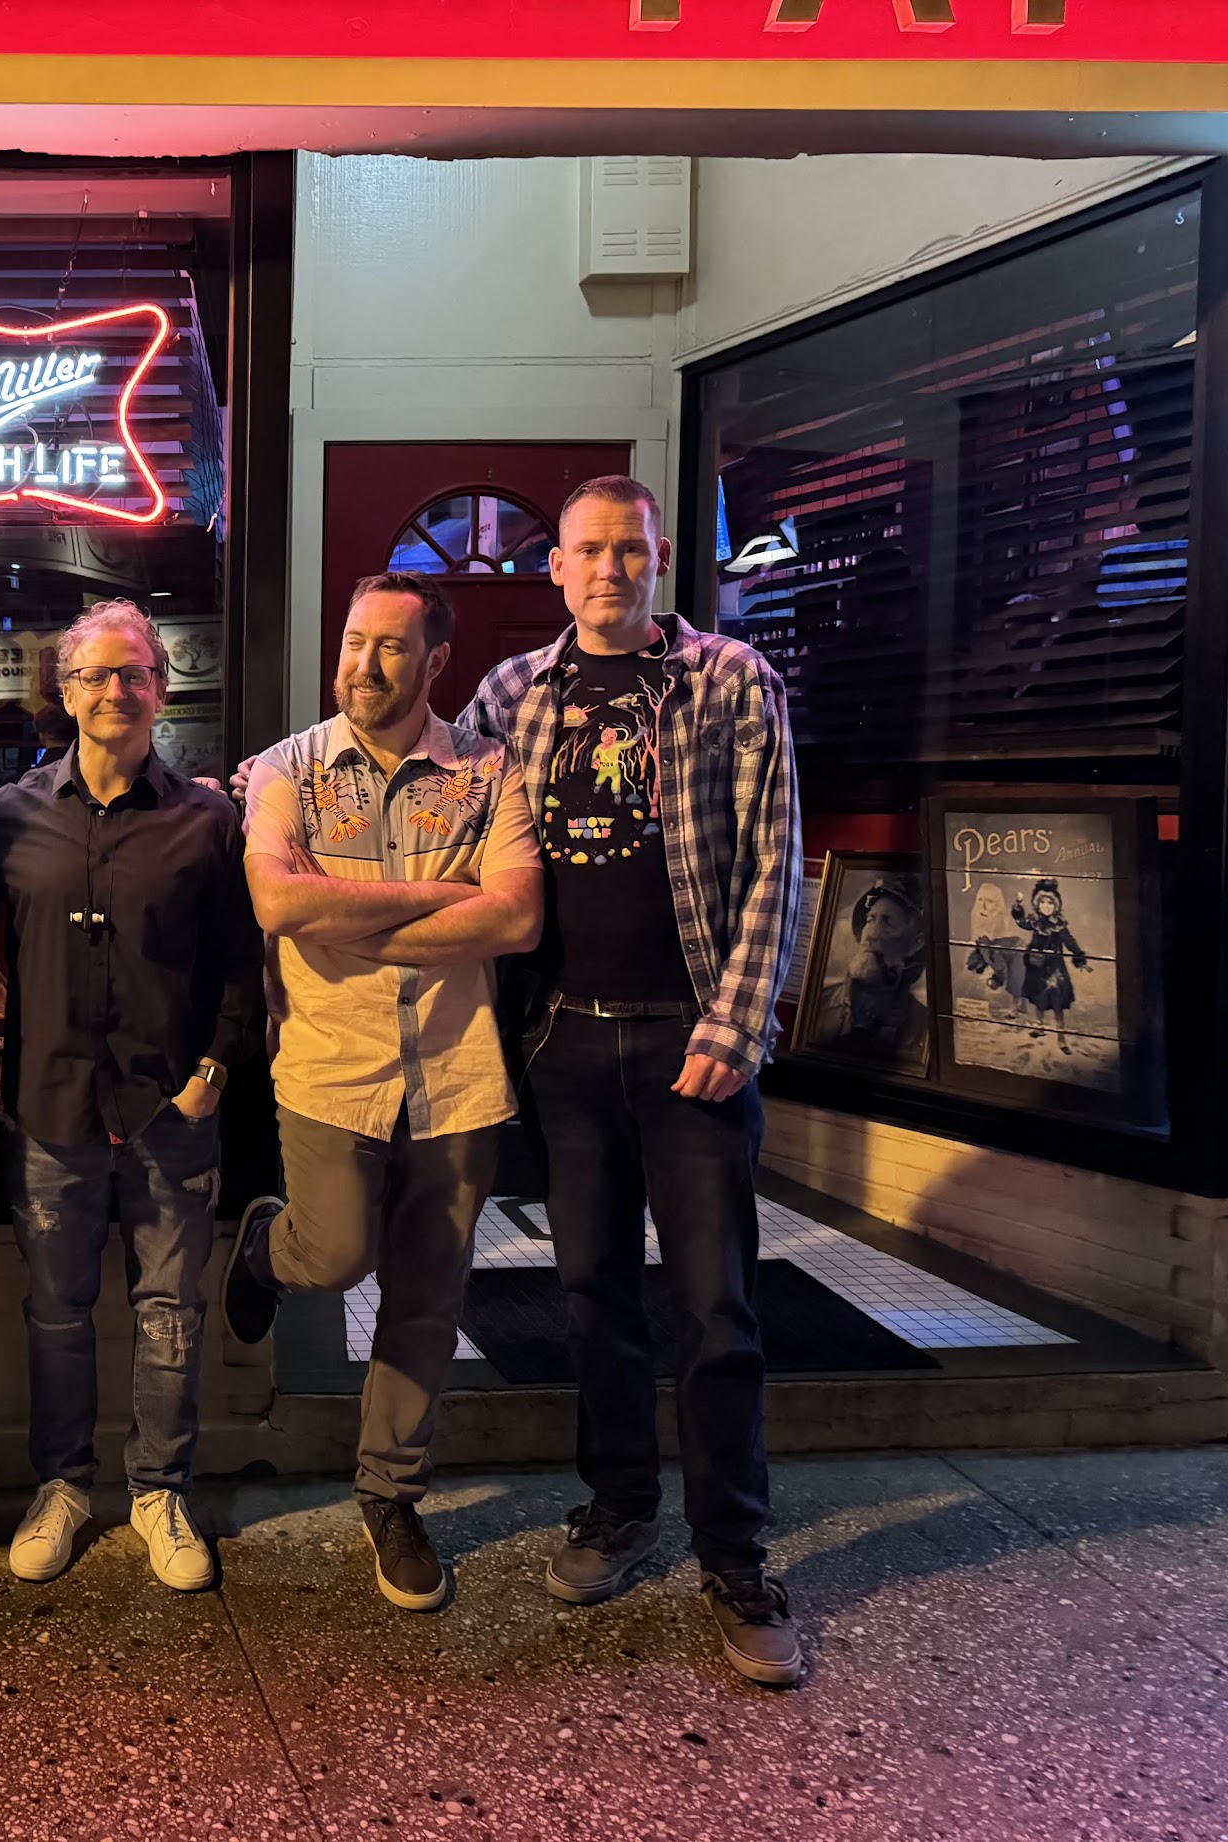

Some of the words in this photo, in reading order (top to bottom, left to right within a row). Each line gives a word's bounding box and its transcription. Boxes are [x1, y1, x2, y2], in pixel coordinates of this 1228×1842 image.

[34, 442, 127, 483] LIFE
[568, 817, 615, 828] MEOW
[568, 828, 611, 839] WOLF
[954, 828, 1053, 893] Pears'
